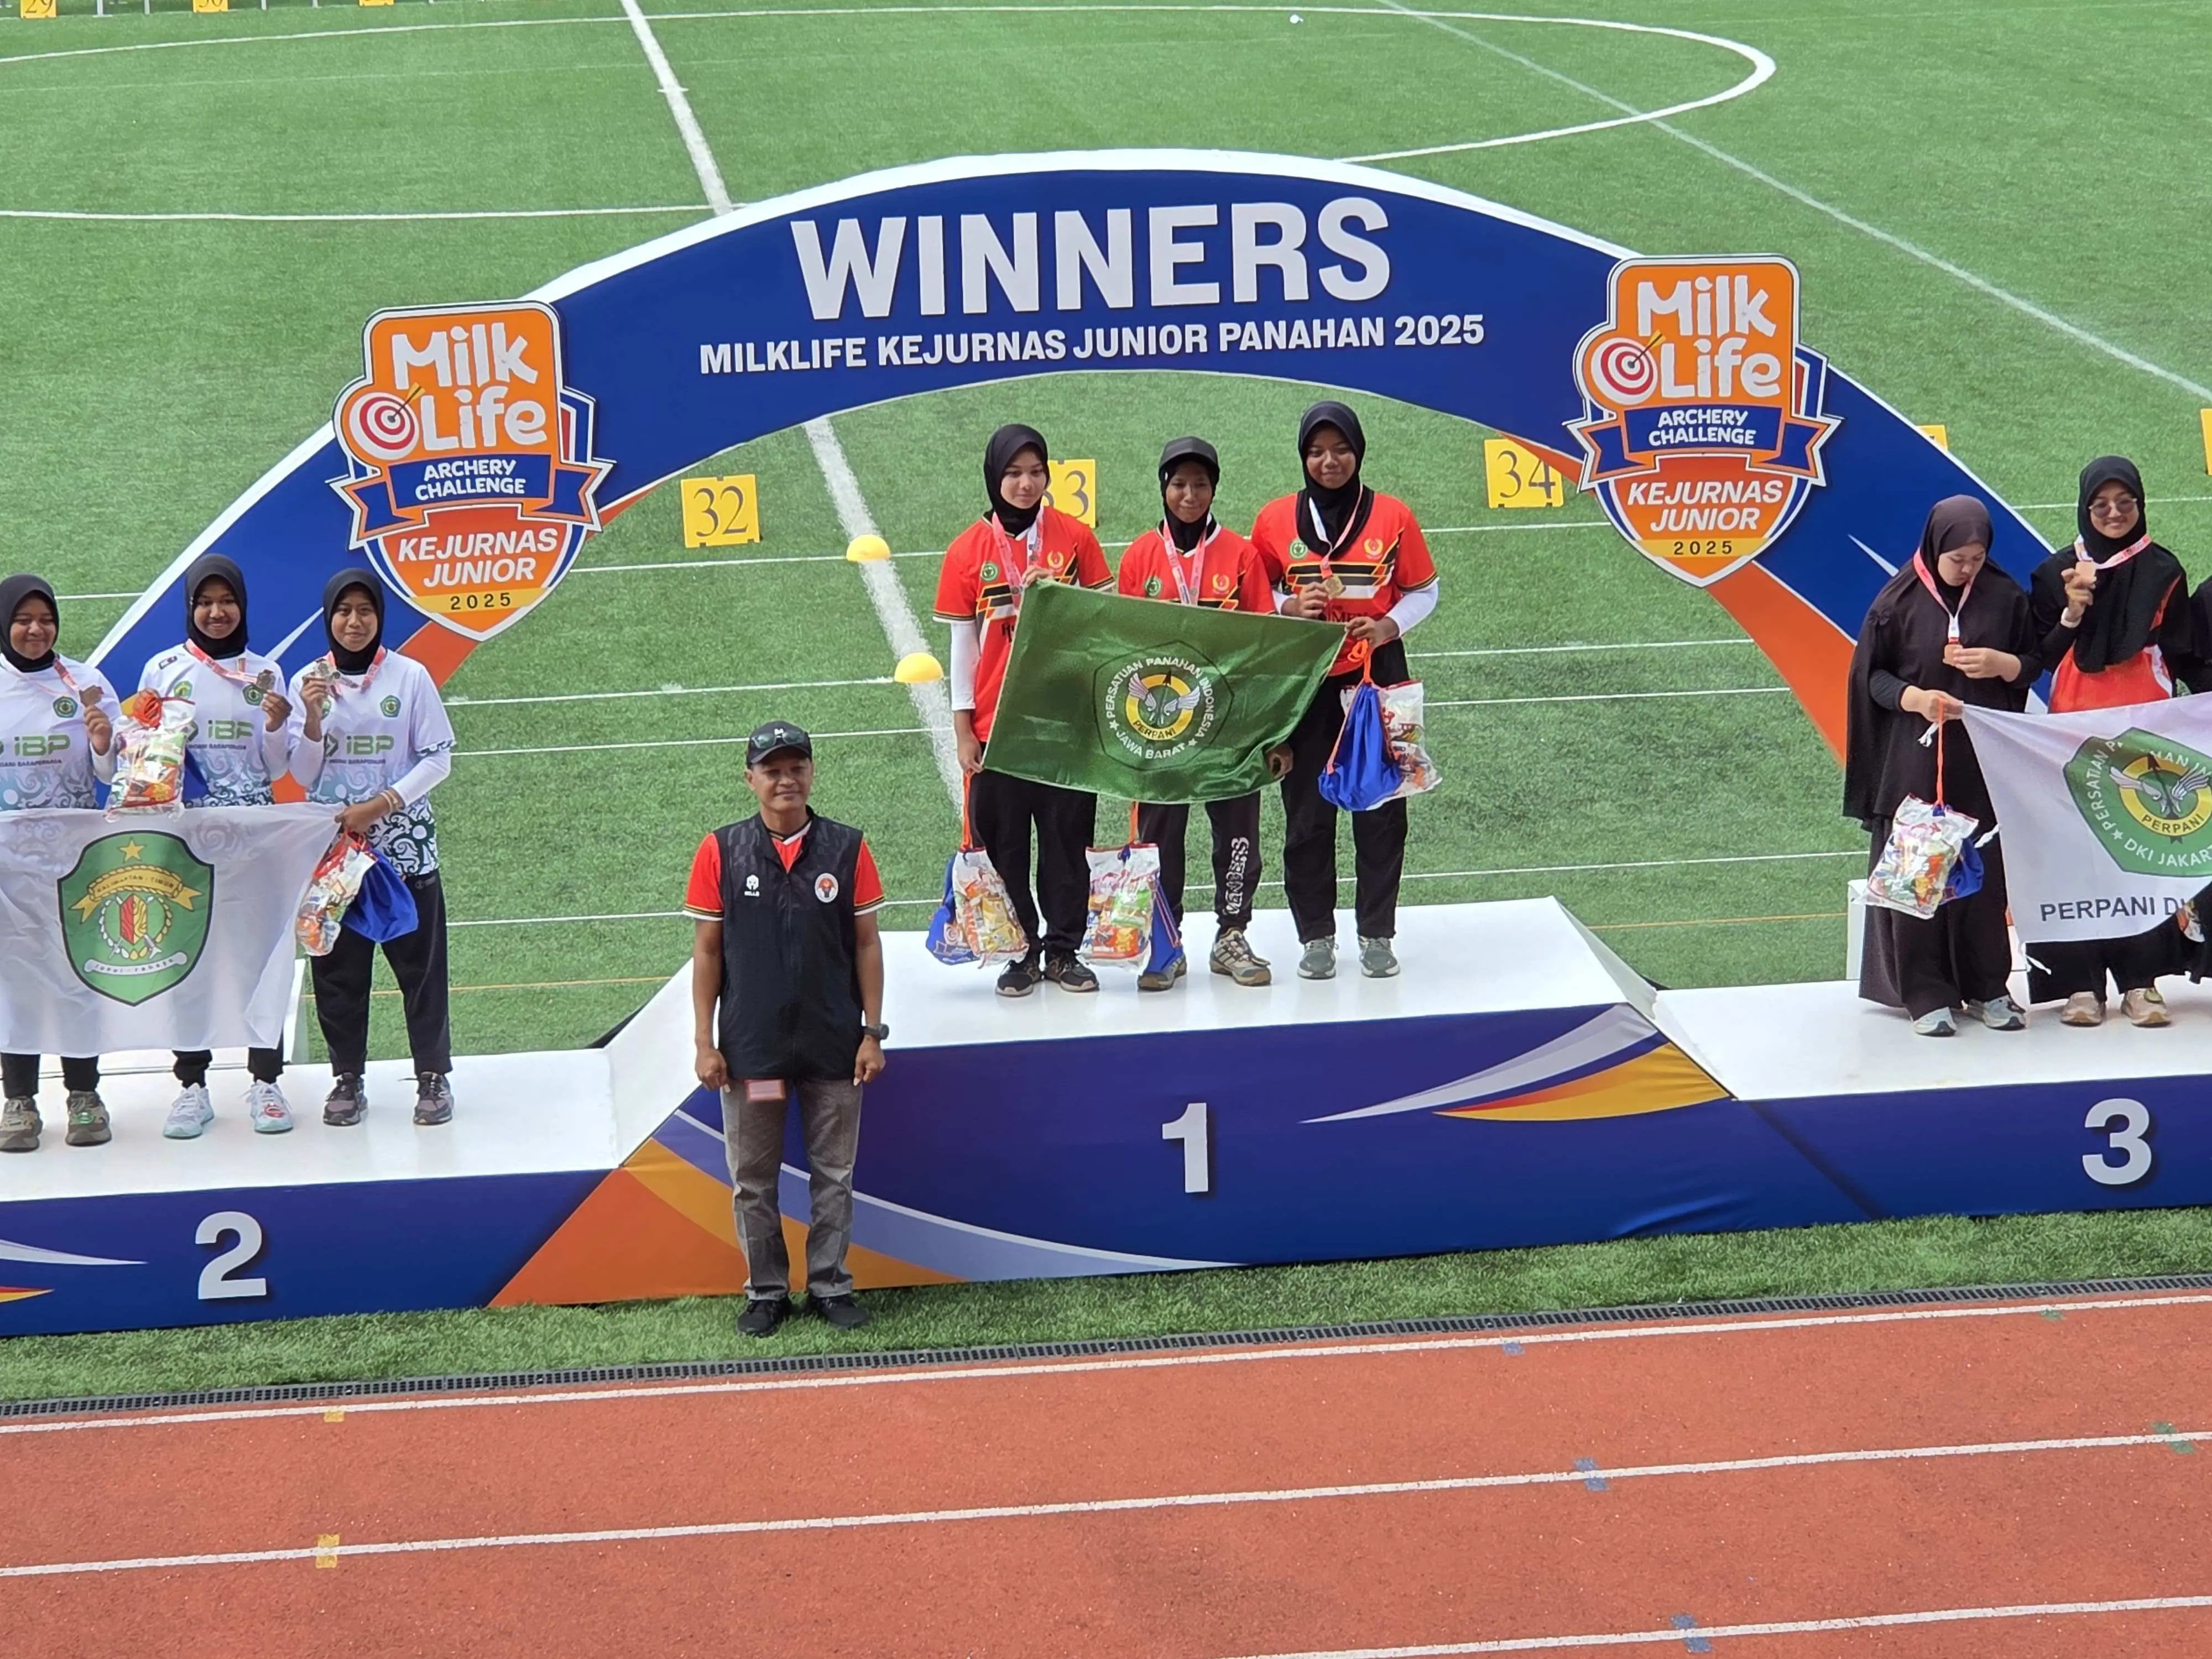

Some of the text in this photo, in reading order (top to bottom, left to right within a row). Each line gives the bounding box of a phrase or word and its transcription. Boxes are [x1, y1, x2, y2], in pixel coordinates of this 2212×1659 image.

[790, 197, 1390, 320] WINNERS
[1637, 274, 1776, 338] Milk
[392, 322, 539, 390] Milk
[700, 314, 1485, 374] MILKLIFE KEJURNAS JUNIOR PANAHAN 2025
[1661, 337, 1781, 399] Life
[420, 386, 547, 451] Life
[1657, 408, 1749, 428] ARCHERY
[1648, 427, 1757, 446] CHALLENGE
[424, 459, 516, 482] ARCHERY
[1498, 450, 1556, 499] 34
[415, 477, 526, 501] CHALLENGE
[1042, 470, 1088, 519] 3
[1627, 479, 1783, 507] KEJURNAS
[693, 485, 748, 537] 32
[1650, 507, 1760, 532] JUNIOR
[398, 528, 559, 562] KEJURNAS
[1673, 540, 1733, 555] 2025
[423, 557, 536, 588] JUNIOR
[450, 592, 512, 611] 2025
[1105, 656, 1214, 738] PERSATUAN PANAHAN INDONESIA
[1116, 729, 1186, 759] JAWA BARAT
[1133, 719, 1176, 740] PERPANI
[2141, 813, 2205, 834] PERPANI
[2124, 837, 2154, 861] DKI
[2039, 896, 2156, 922] PERPANI
[1162, 1102, 1209, 1193] 1
[2082, 1098, 2152, 1185] 3
[195, 1211, 267, 1300] 2
